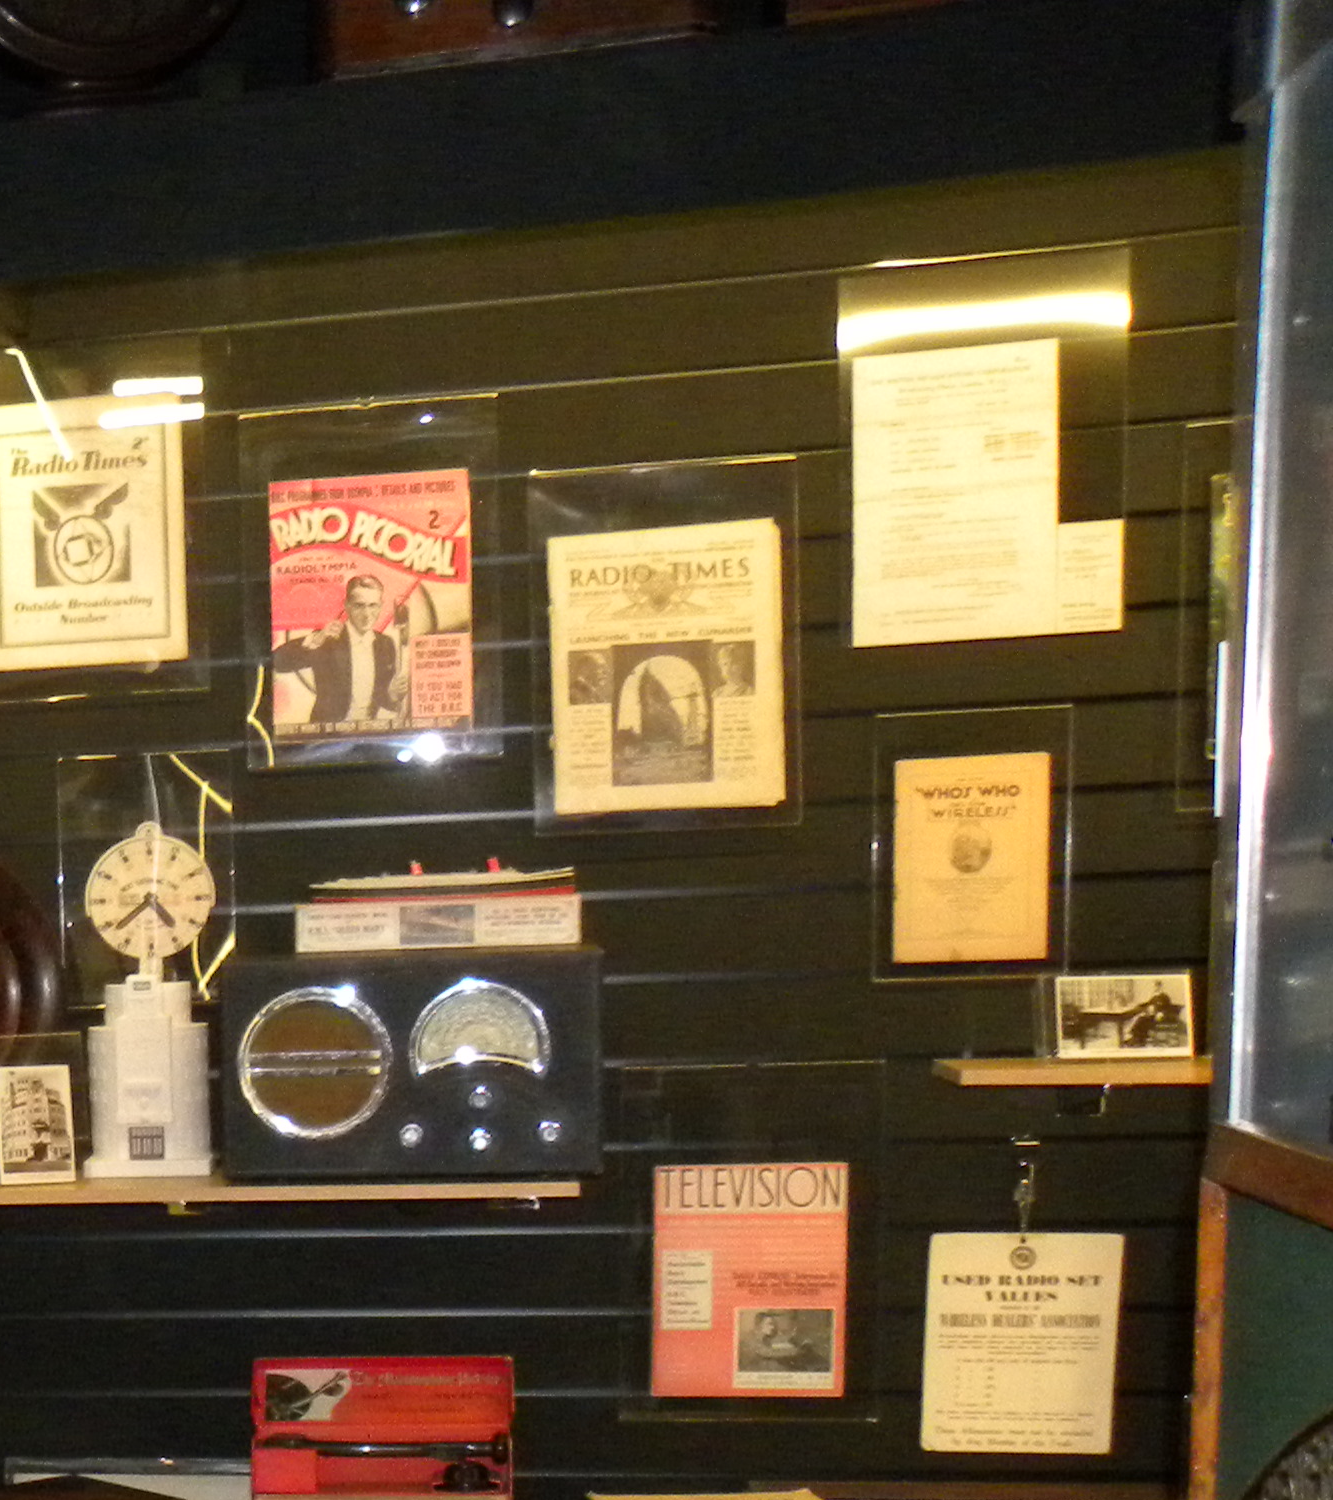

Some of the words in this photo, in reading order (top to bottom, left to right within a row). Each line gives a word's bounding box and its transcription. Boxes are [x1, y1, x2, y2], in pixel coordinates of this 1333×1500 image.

[11, 453, 79, 477] Radio
[81, 449, 148, 472] Times
[271, 506, 349, 553] RADIO
[349, 510, 458, 579] PICTORIAL
[276, 562, 358, 575] RADIOLYMPIA
[570, 563, 653, 588] RADIO
[668, 556, 751, 583] TIMES
[14, 599, 63, 613] Outside
[68, 595, 154, 610] Broadcasting
[570, 631, 630, 645] LAUNCHING
[978, 784, 1020, 798] WHO
[660, 1166, 841, 1208] TELEVISION
[941, 1274, 991, 1286] USED
[998, 1274, 1060, 1286] RADIO
[1066, 1274, 1102, 1287] SET
[985, 1290, 1058, 1301] VALUES
[939, 1313, 987, 1328] WIRELESS
[1040, 1314, 1101, 1329] ASSOCIATION
